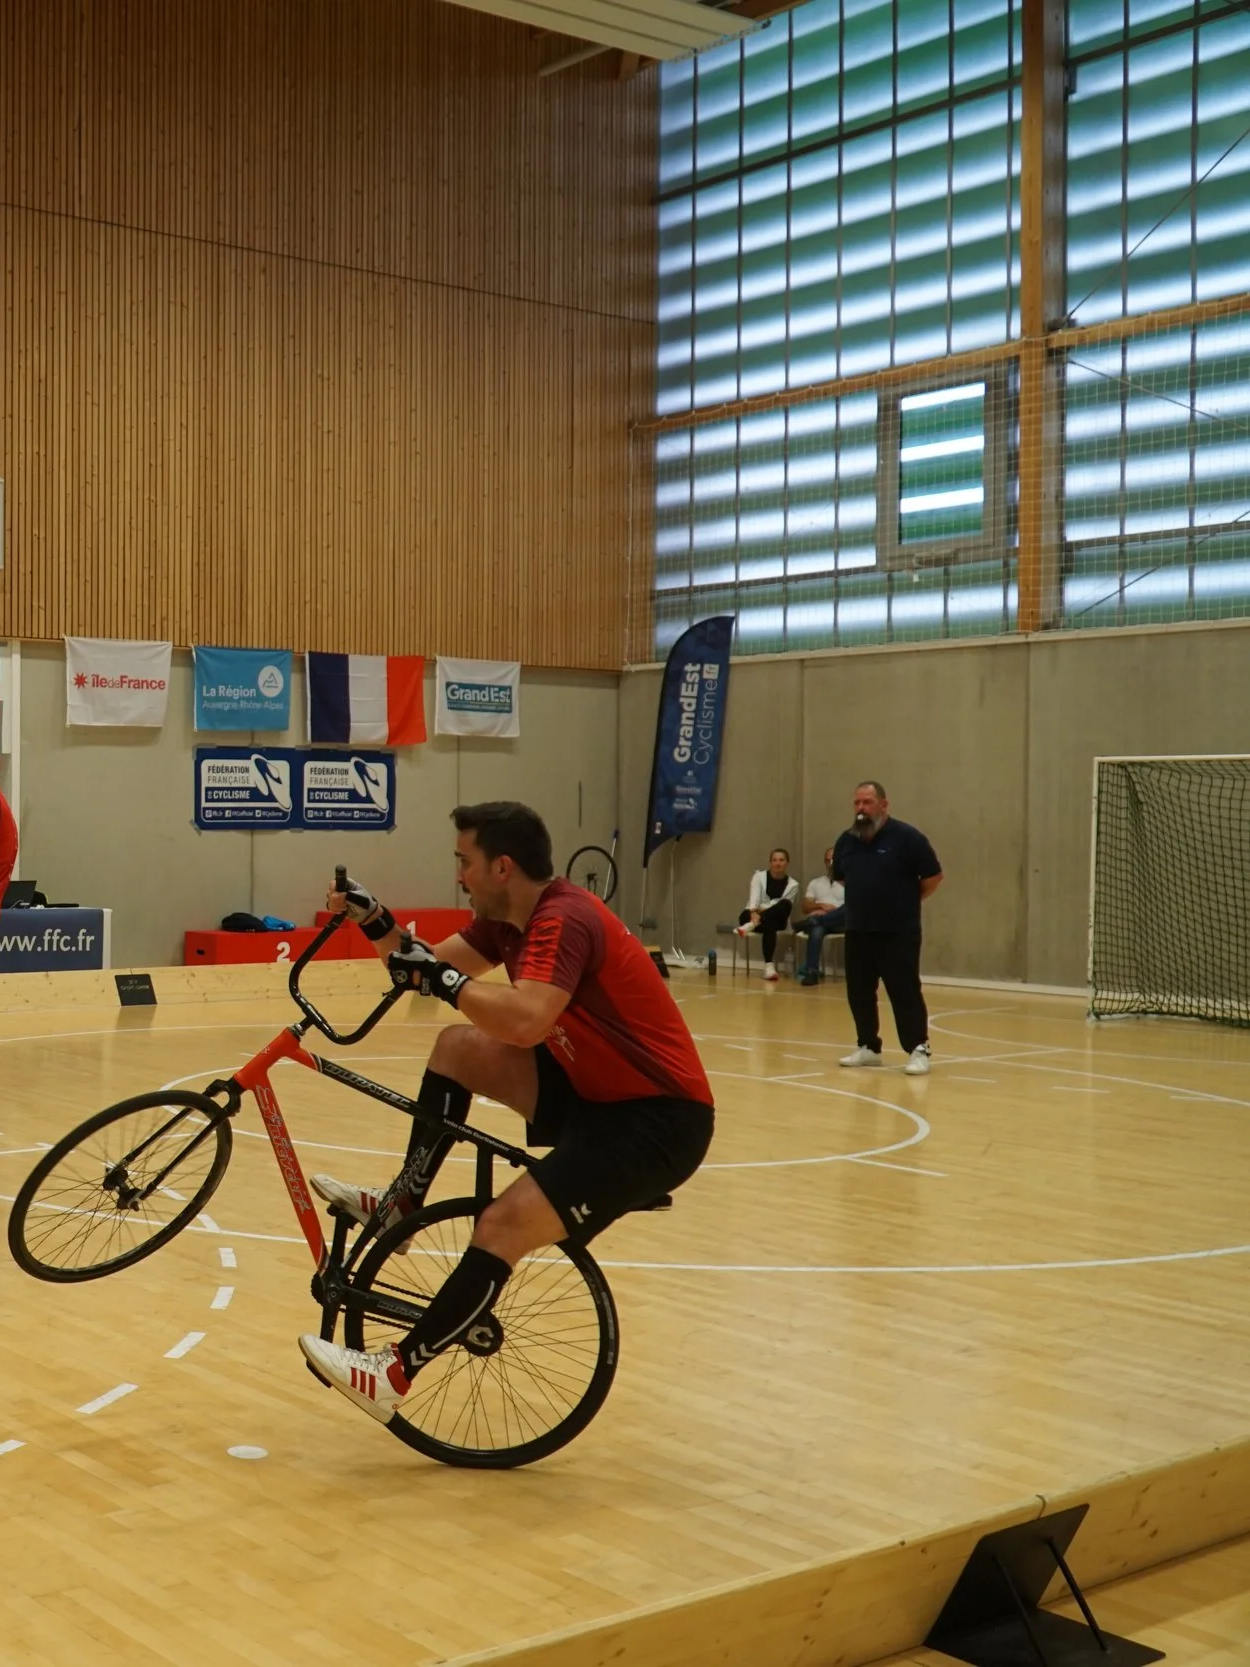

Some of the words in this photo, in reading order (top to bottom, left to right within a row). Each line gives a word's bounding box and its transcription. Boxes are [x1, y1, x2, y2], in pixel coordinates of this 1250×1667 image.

[202, 685, 216, 697] La
[218, 684, 257, 699] Région
[673, 663, 702, 764] GrandEst
[207, 764, 250, 774] FÉDÉRATION
[310, 765, 350, 775] FÉDÉRATION
[207, 775, 251, 785] FRANÇAISE
[310, 777, 350, 786] FRANÇAISE
[213, 790, 251, 799] CYCLISME
[314, 791, 350, 800] CYCLISME
[406, 921, 417, 936] 1
[276, 941, 291, 963] 2
